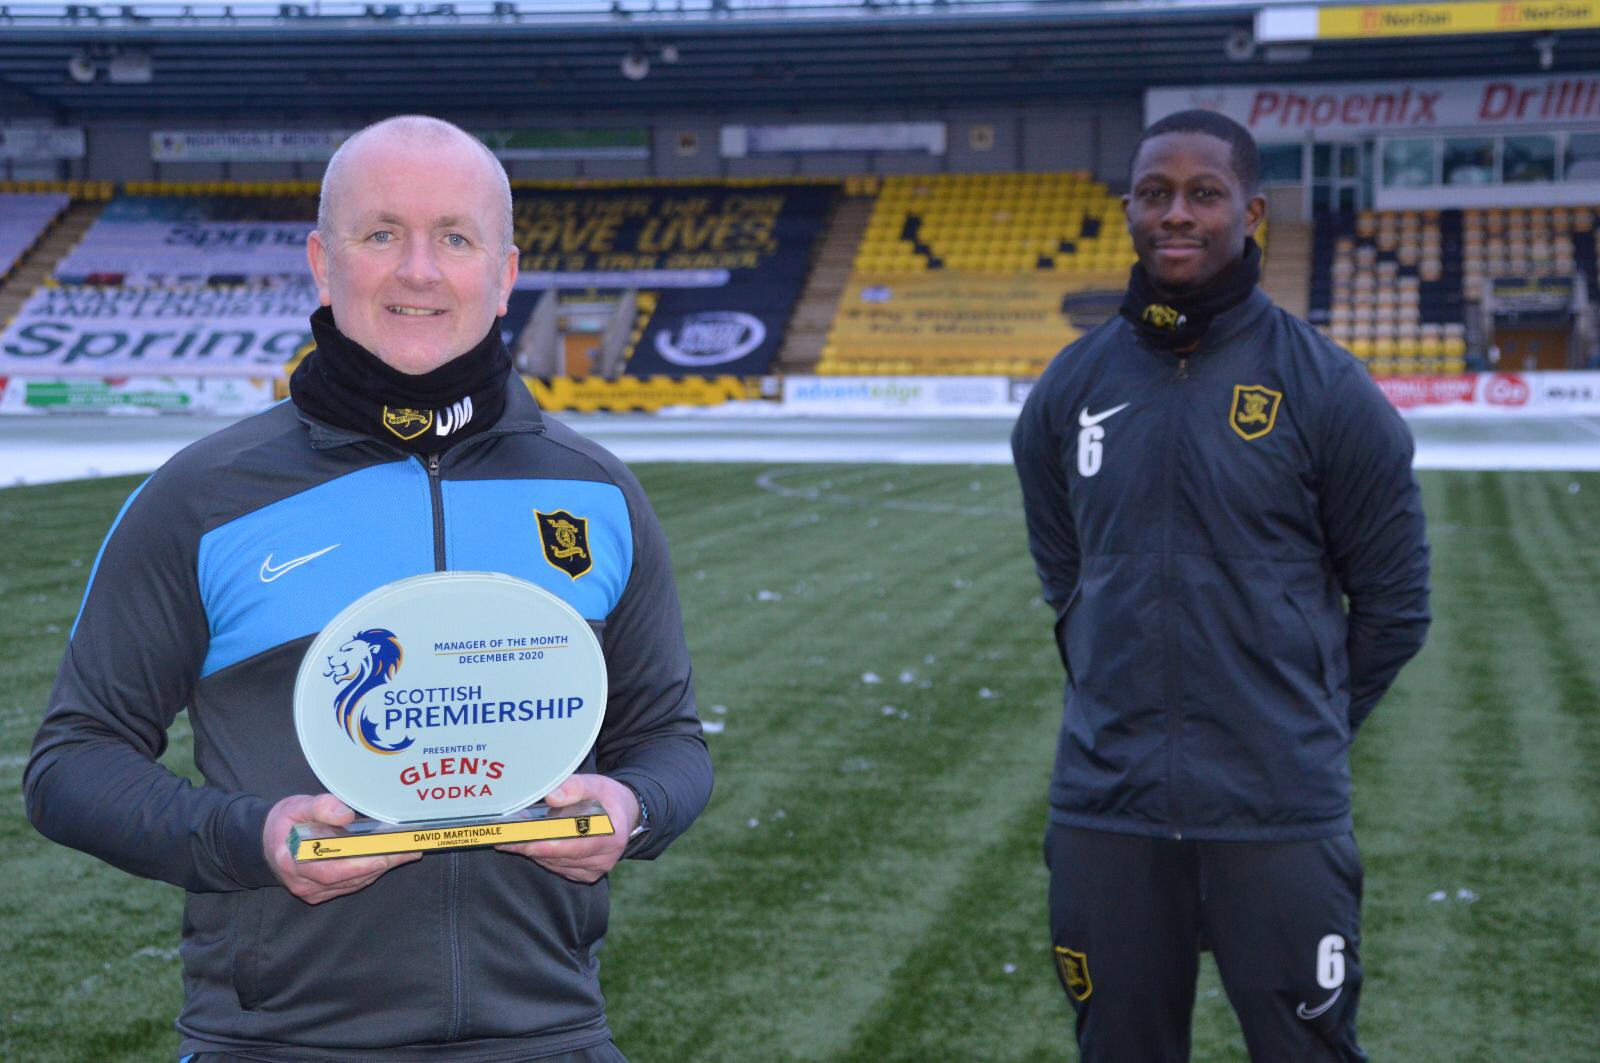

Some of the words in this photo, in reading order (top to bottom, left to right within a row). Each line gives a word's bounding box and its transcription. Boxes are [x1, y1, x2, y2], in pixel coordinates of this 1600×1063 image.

[1248, 86, 1443, 128] Phoenix
[4, 321, 312, 364] Spring
[1077, 424, 1105, 477] 6
[434, 639, 487, 652] MANAGER
[489, 638, 505, 649] OF
[507, 637, 528, 648] THE
[530, 635, 569, 646] MONTH
[458, 652, 516, 664] DECEMBER
[518, 651, 544, 661] 2020
[384, 685, 482, 706] SCOTTISH
[385, 697, 584, 730] PREMIERSHIP
[423, 745, 473, 755] PRESENTED
[476, 743, 487, 752] BY
[416, 784, 492, 801] VODKA
[414, 831, 441, 842] DAVID
[444, 827, 502, 839] MARTINDALE
[437, 839, 470, 847] LIVINGSTON
[1317, 933, 1345, 989] 6
